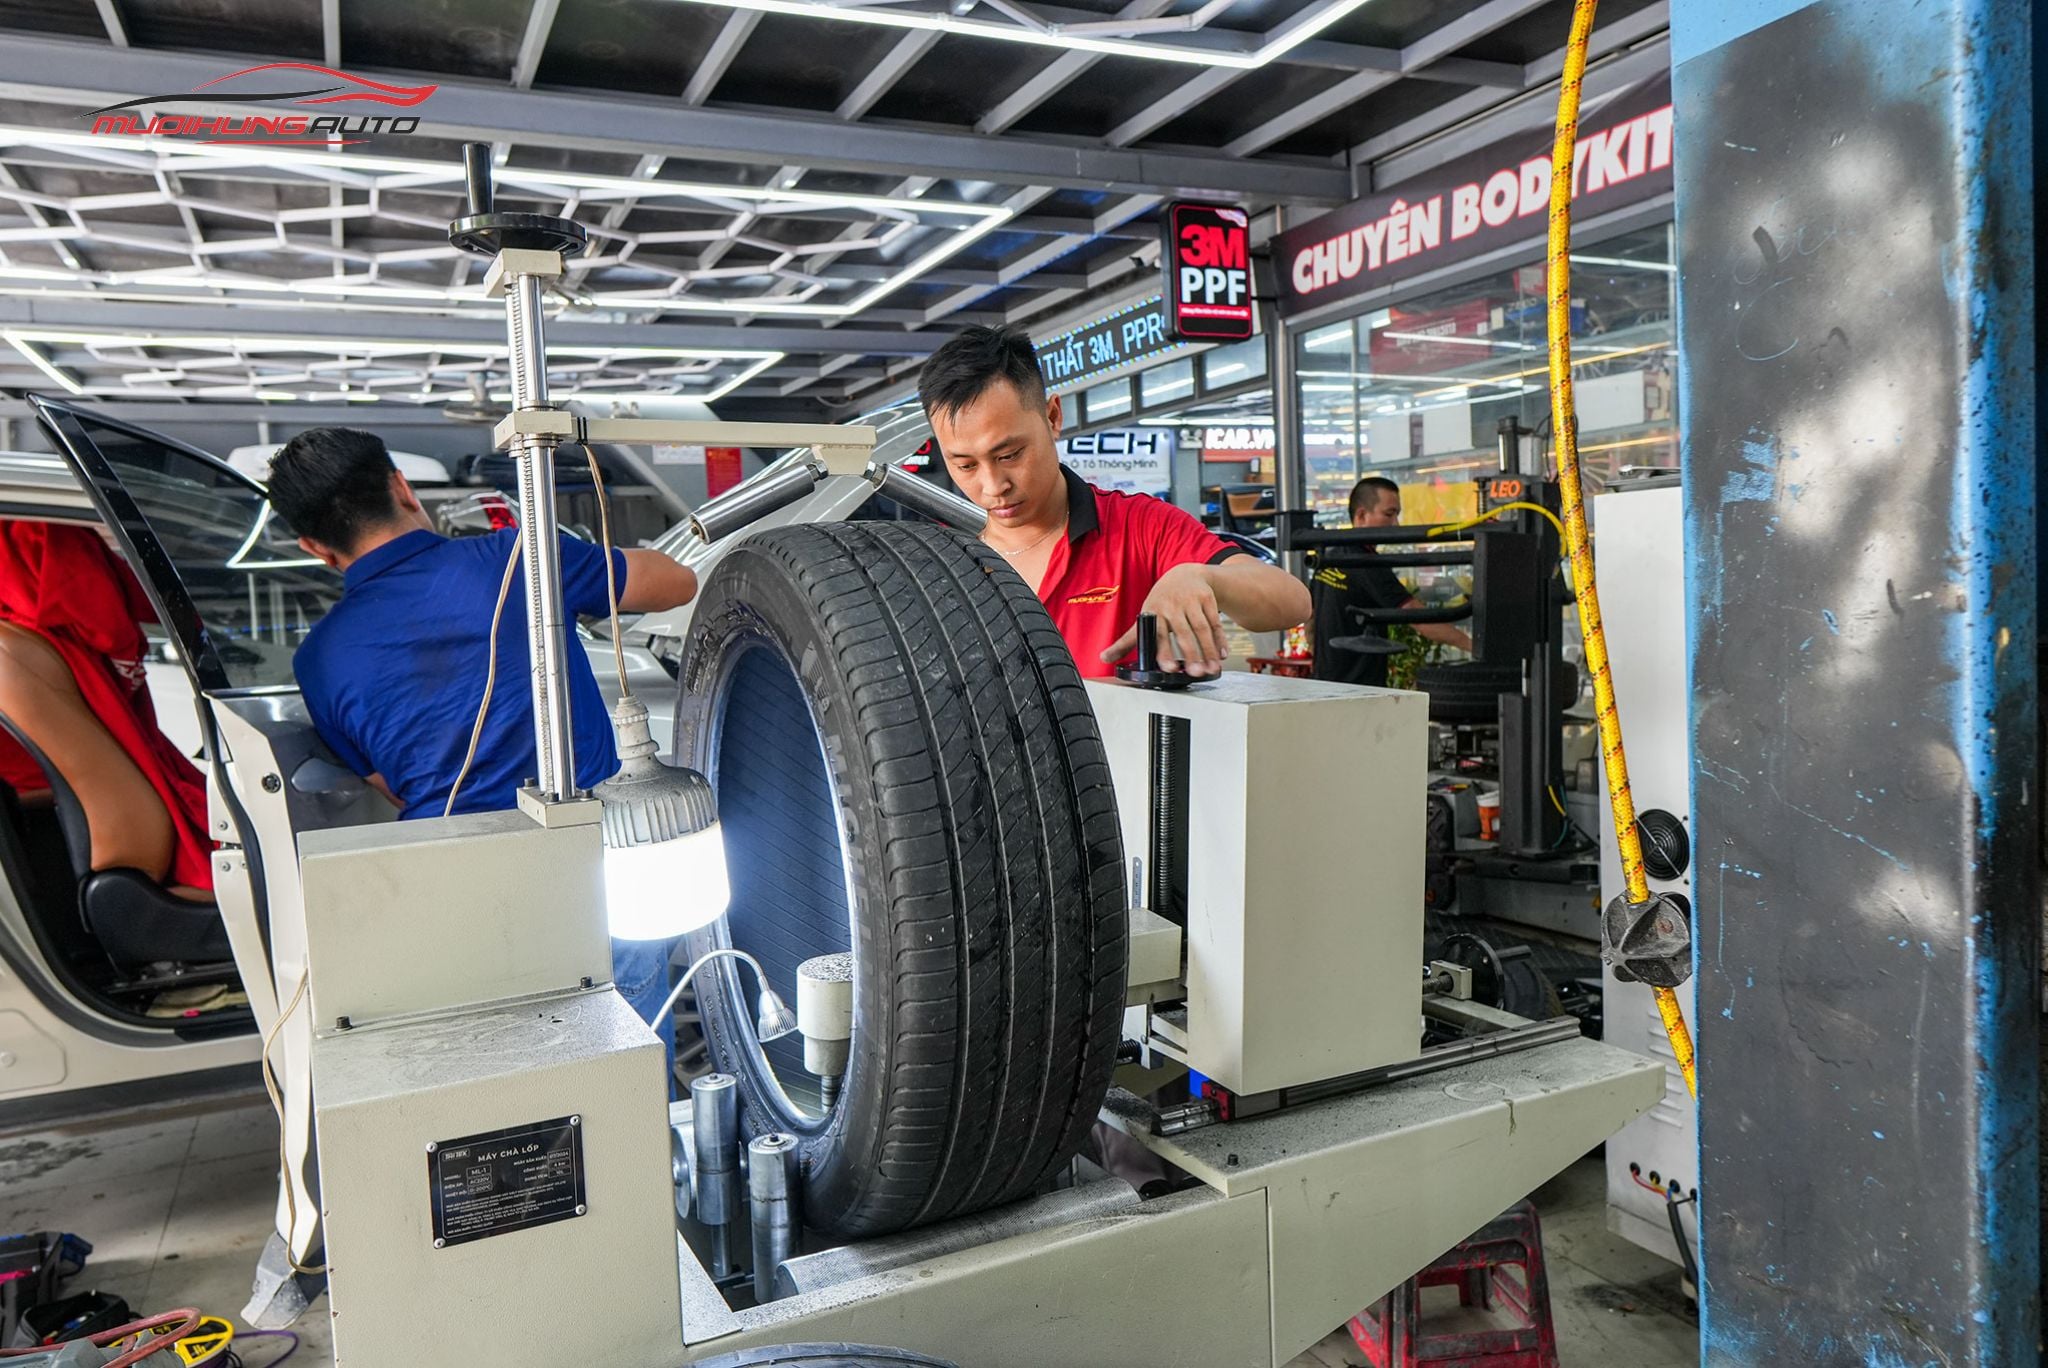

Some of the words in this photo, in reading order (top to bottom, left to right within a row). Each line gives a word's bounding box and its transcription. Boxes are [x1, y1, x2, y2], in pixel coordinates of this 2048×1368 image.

[1180, 223, 1246, 269] 3M
[1292, 194, 1442, 295] CHUYÊN
[1180, 266, 1246, 306] PPF
[1067, 432, 1157, 454] ECH
[1098, 458, 1131, 471] Thông
[1133, 459, 1158, 468] Minh
[1490, 480, 1521, 498] LEO
[477, 1152, 498, 1162] MÁY
[500, 1147, 519, 1158] CHÀ
[521, 1143, 539, 1154] LỐP
